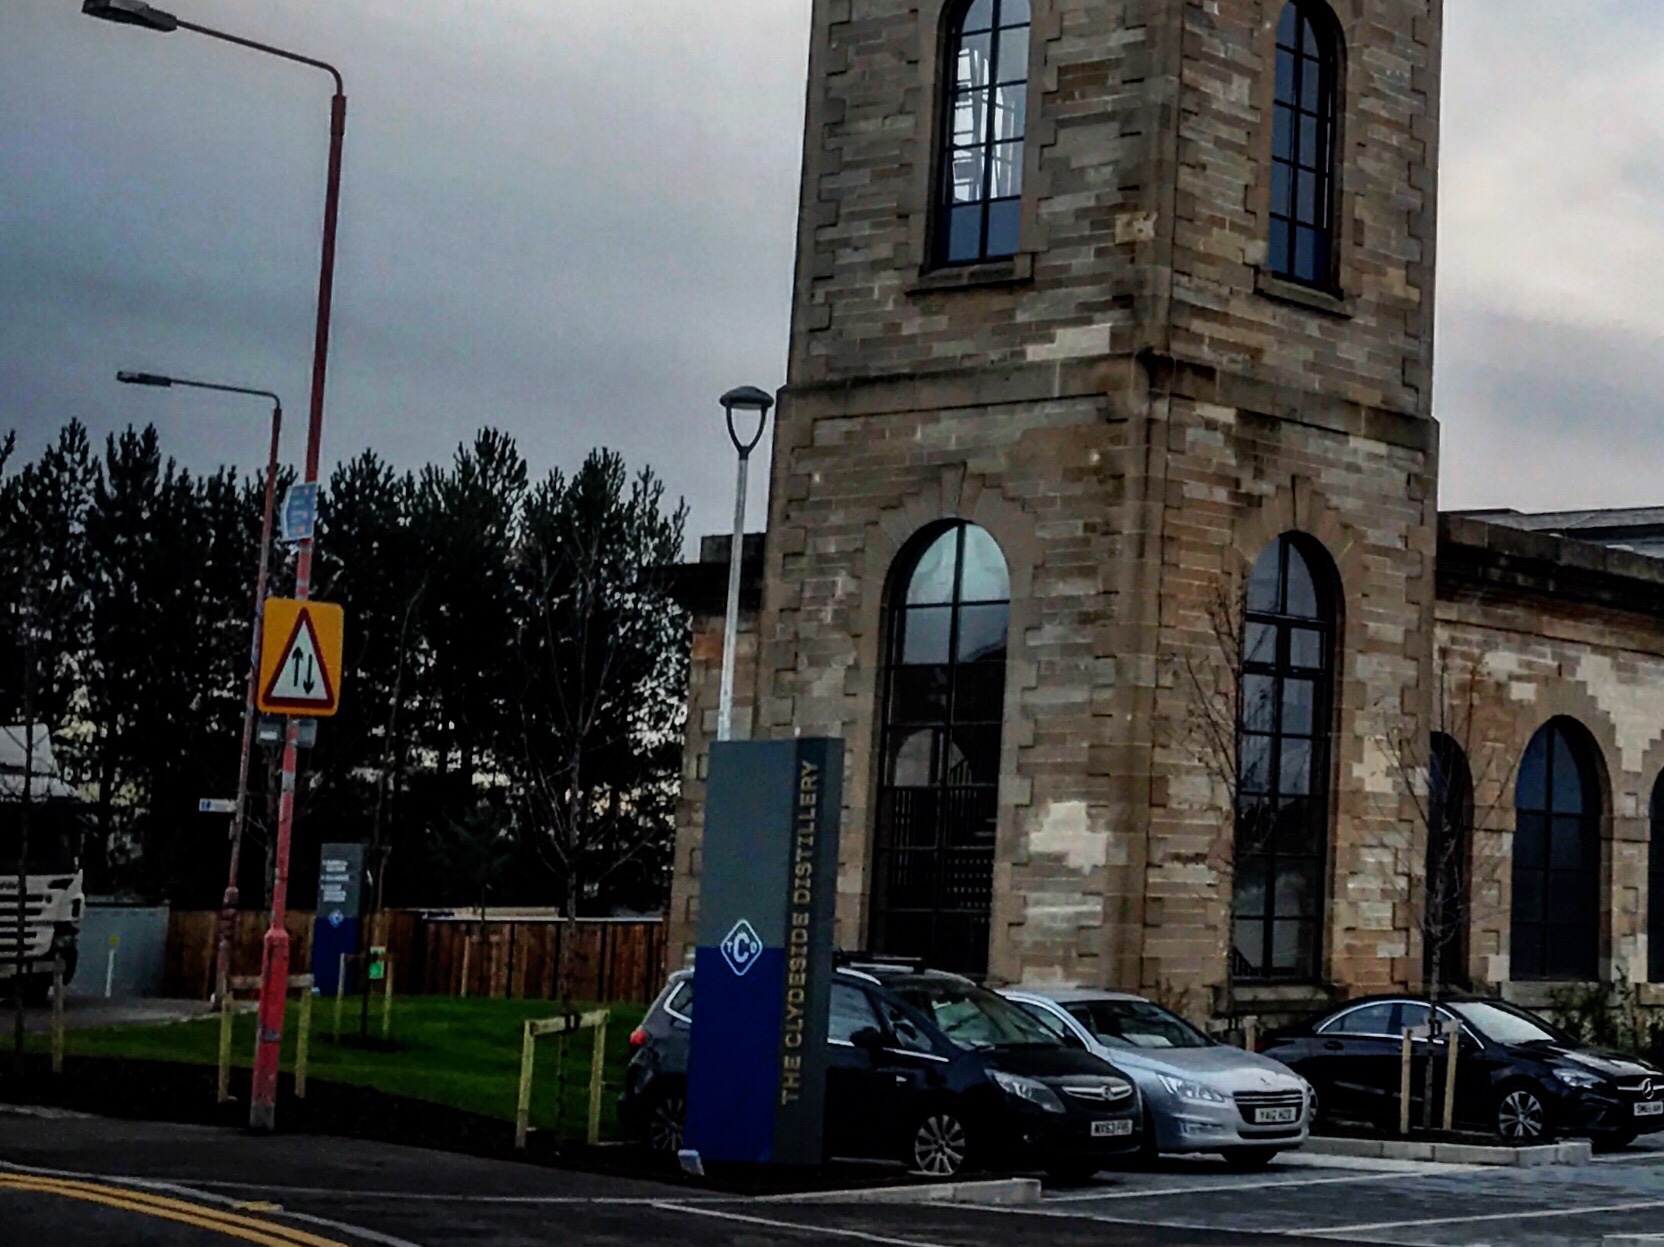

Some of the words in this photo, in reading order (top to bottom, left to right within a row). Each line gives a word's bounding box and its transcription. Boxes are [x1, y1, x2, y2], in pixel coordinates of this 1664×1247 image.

[793, 760, 819, 904] DISTILLERY
[785, 912, 810, 1048] CLYDESIDE
[782, 1055, 802, 1105] THE
